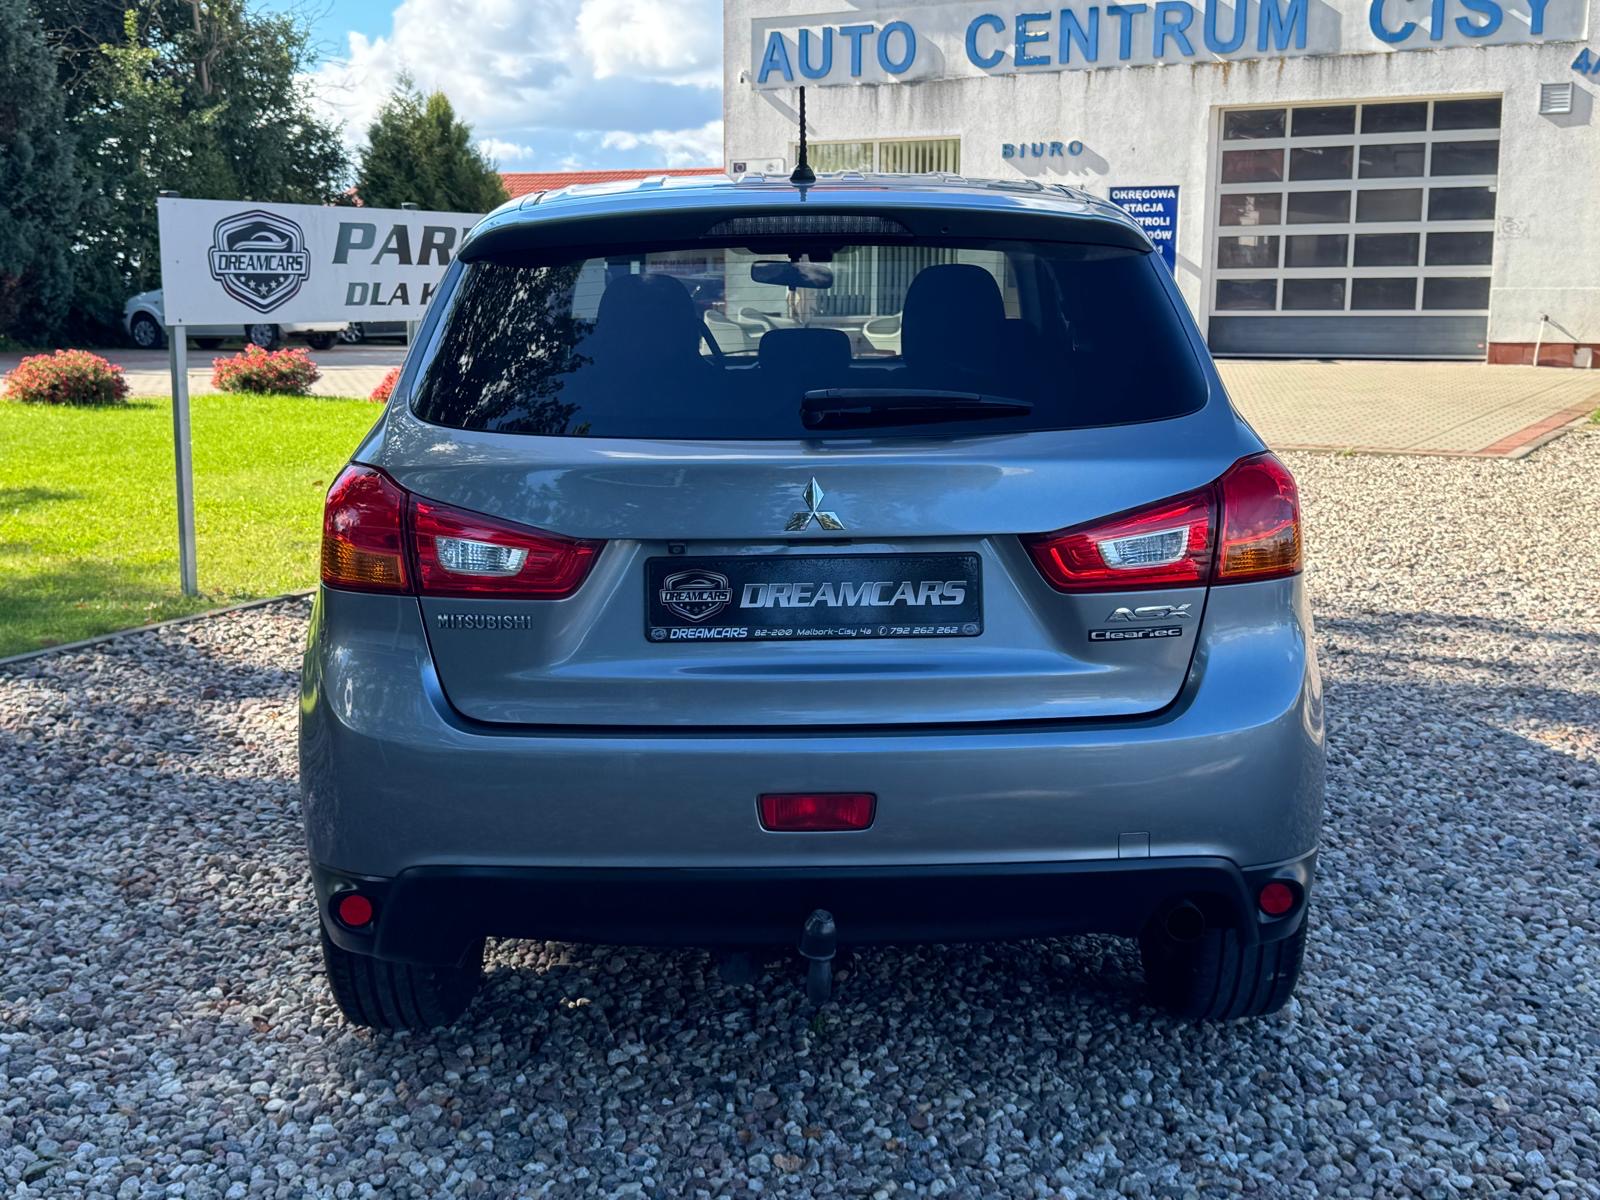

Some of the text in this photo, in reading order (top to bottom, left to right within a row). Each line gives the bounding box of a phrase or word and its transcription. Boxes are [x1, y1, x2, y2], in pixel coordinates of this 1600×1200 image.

[758, 0, 1548, 84] AUTO CENTRUM CISY
[1002, 140, 1084, 159] BIURO
[1112, 190, 1175, 201] OKRĘGOWA
[1123, 203, 1164, 213] STACJA
[332, 222, 473, 266] PAR
[218, 254, 304, 272] DREAMCARS
[345, 282, 410, 306] DLA
[664, 591, 729, 602] DREAMCARS
[739, 580, 967, 608] DREAMCARS
[437, 614, 533, 629] MITSUBISHI
[1104, 604, 1193, 622] ASX
[670, 628, 748, 639] DREAMCARS
[754, 629, 793, 637] 82-200
[797, 627, 857, 637] Malbork-Cisy
[890, 627, 910, 635] 792
[913, 627, 934, 635] 262
[937, 626, 958, 634] 262
